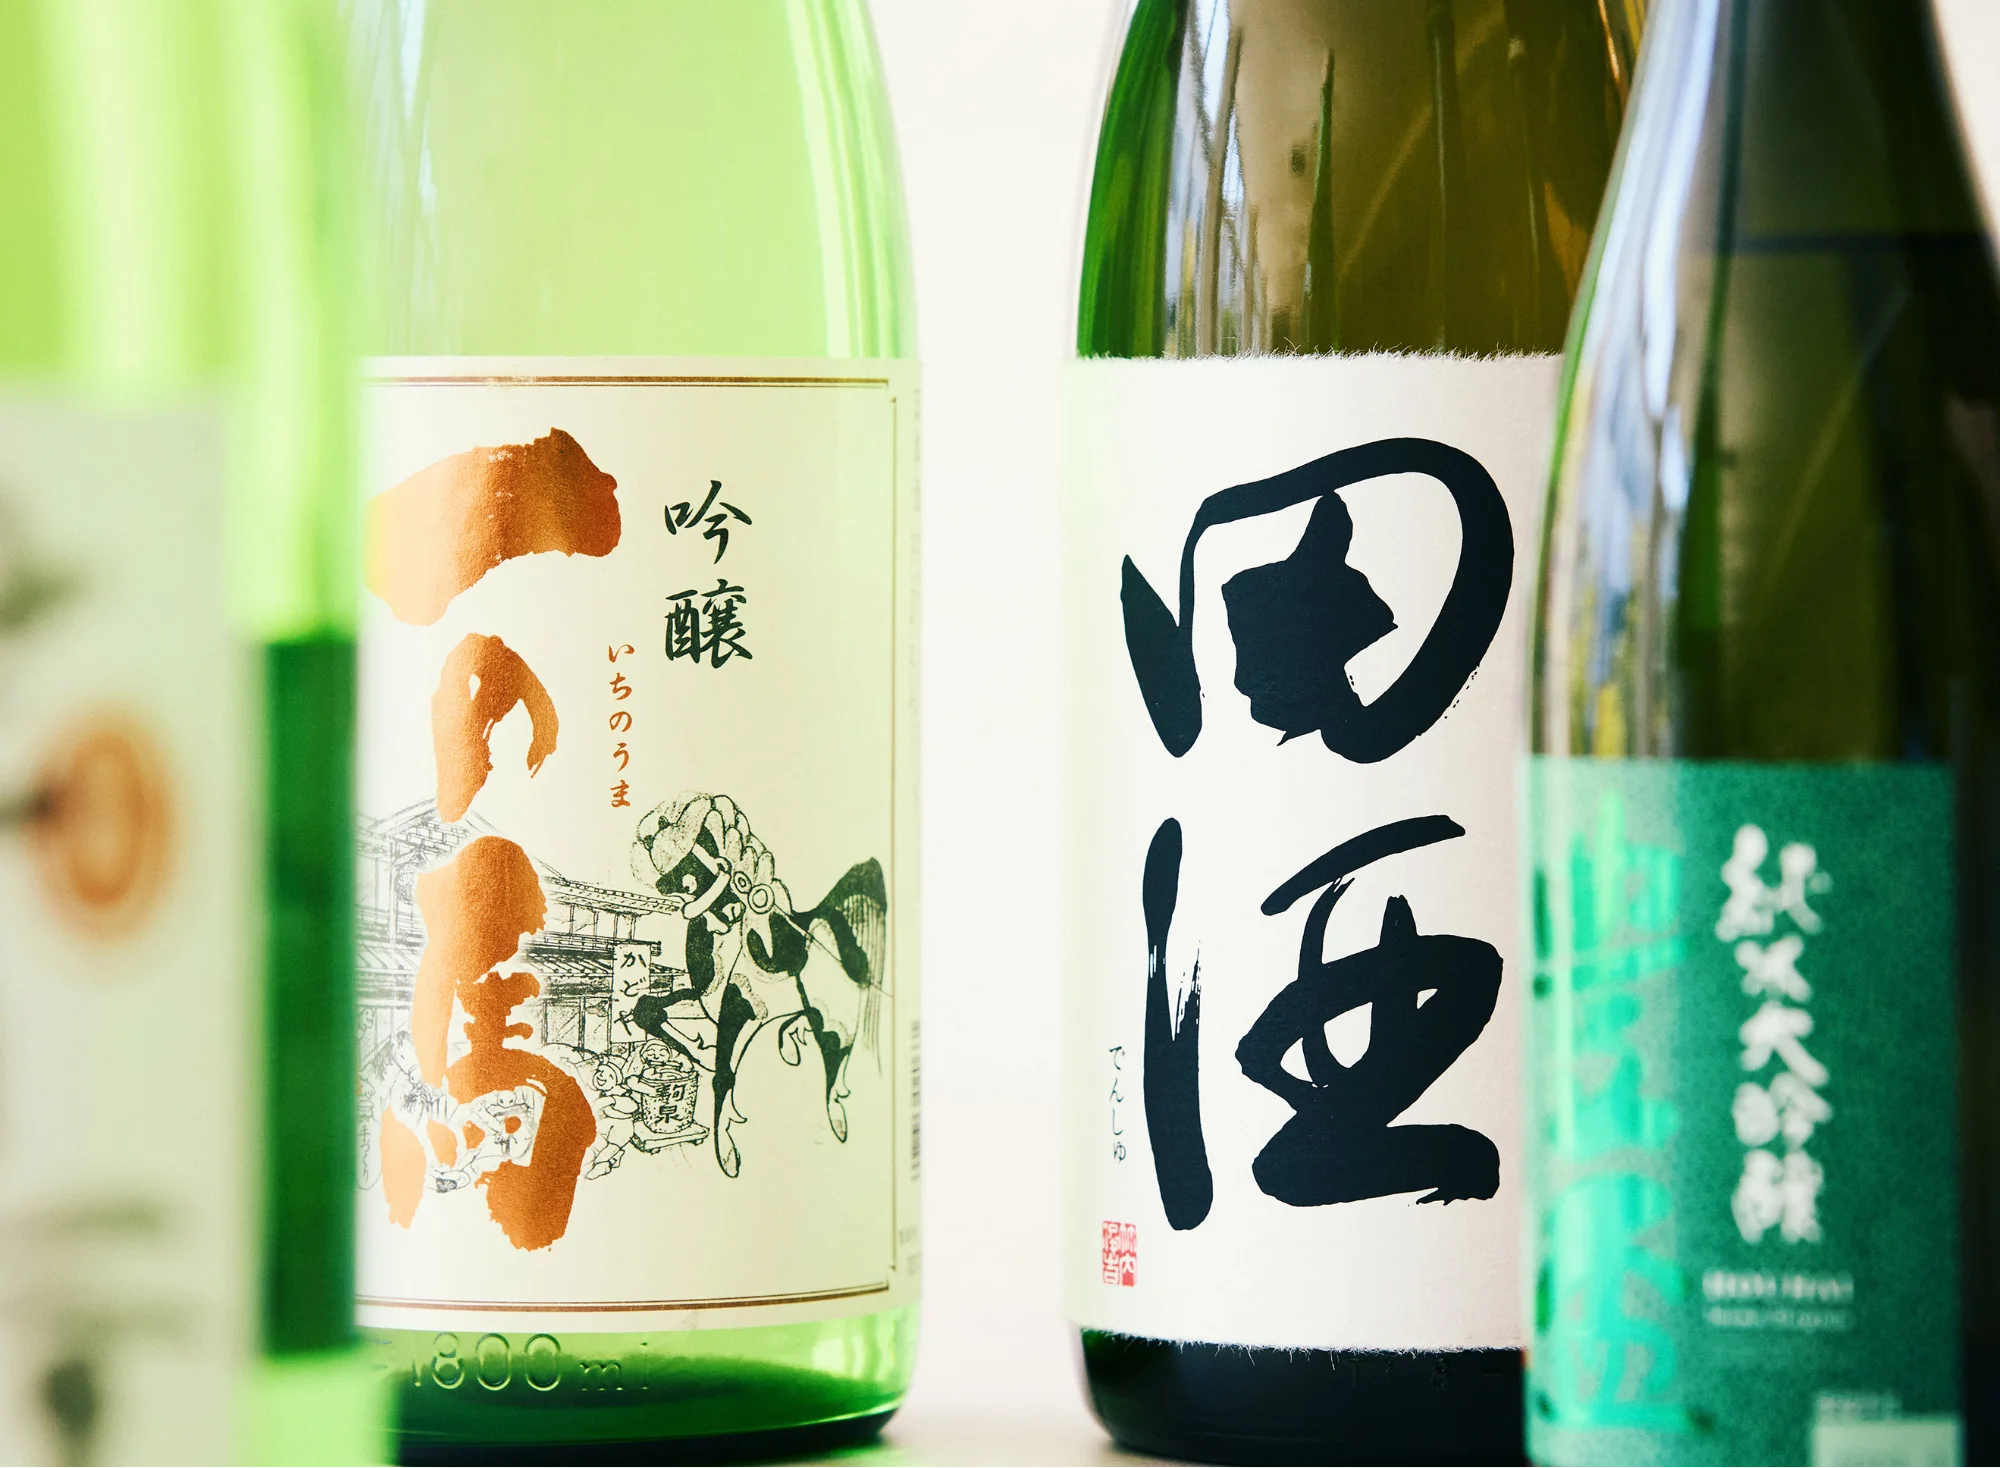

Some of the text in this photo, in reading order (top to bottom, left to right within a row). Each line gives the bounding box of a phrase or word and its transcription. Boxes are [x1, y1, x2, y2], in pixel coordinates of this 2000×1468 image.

[664, 480, 753, 668] 吟醸
[607, 642, 635, 809] いちのうま
[1120, 437, 1514, 1231] 田酒
[614, 951, 647, 1036] かどや
[1108, 1045, 1127, 1164] でんしゅ
